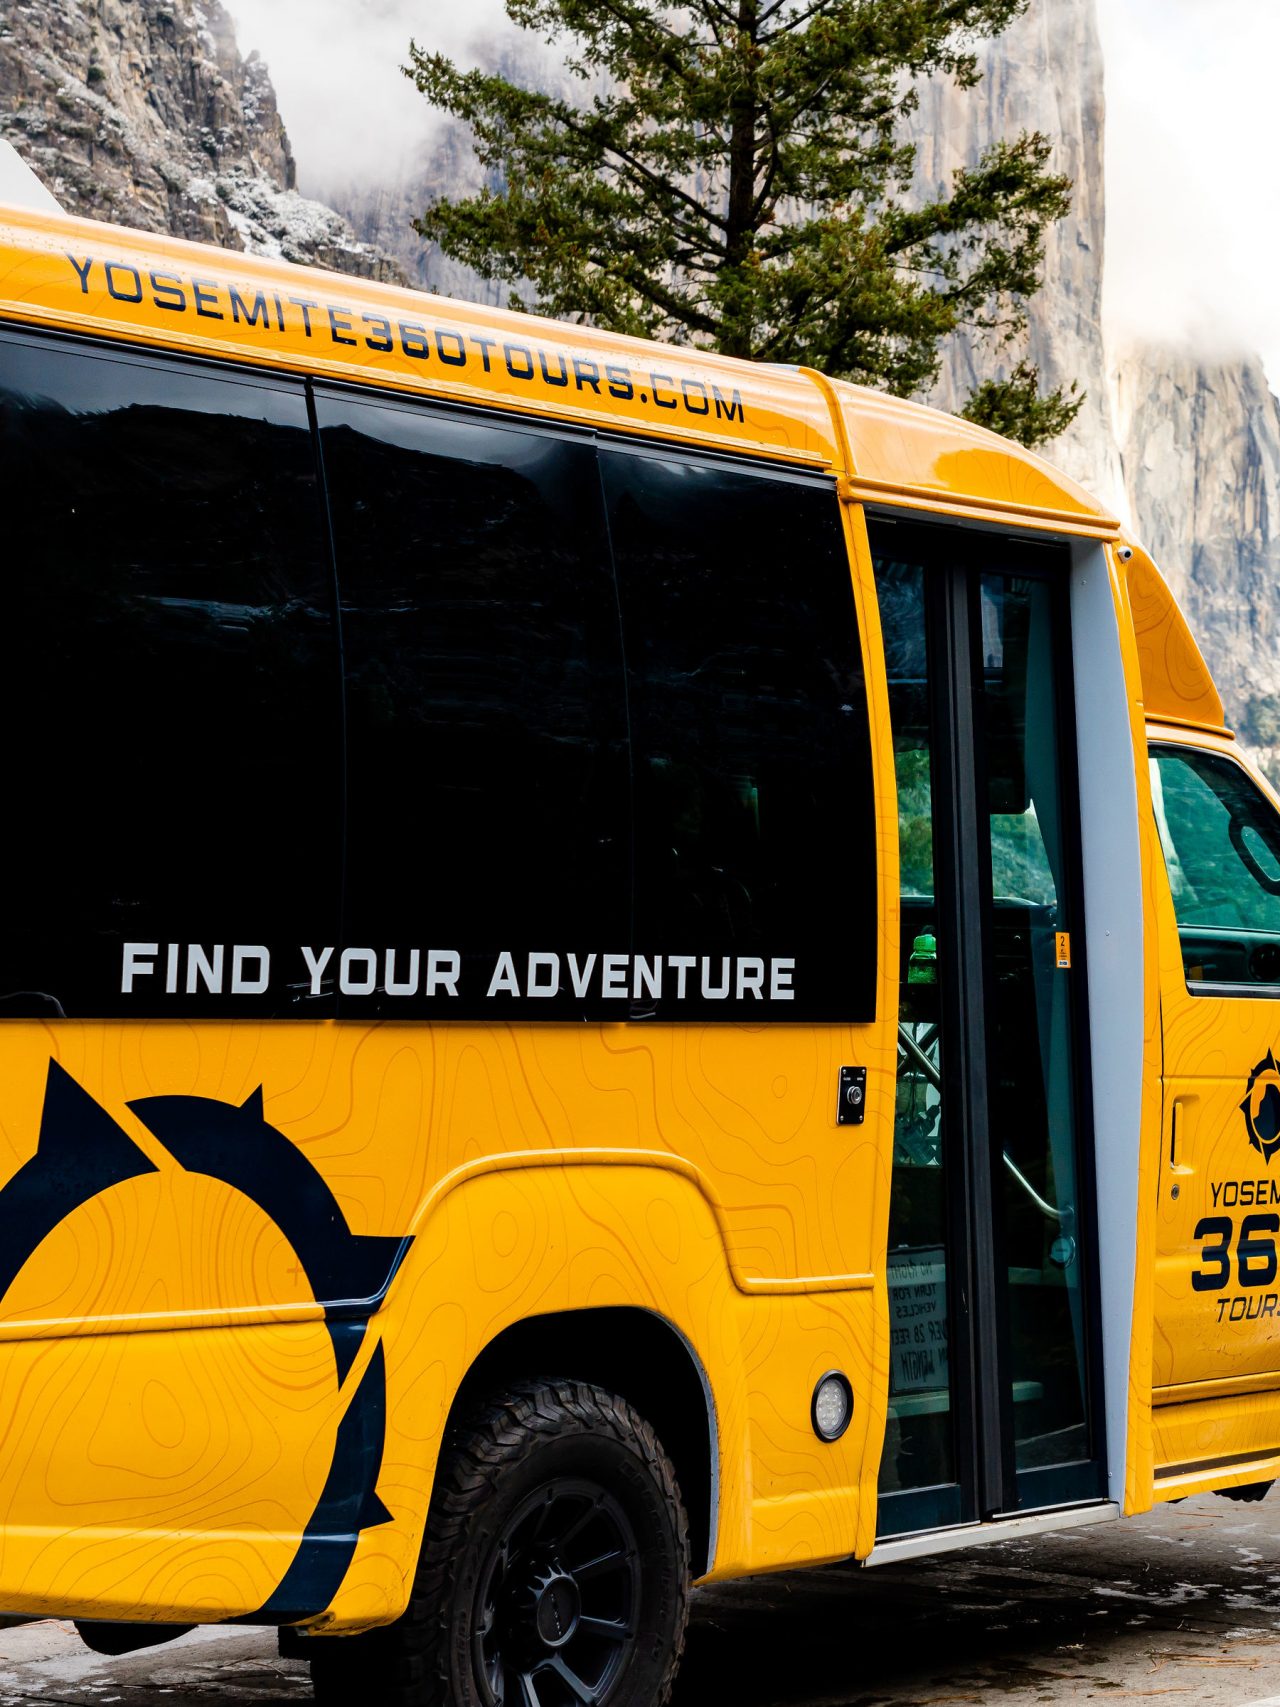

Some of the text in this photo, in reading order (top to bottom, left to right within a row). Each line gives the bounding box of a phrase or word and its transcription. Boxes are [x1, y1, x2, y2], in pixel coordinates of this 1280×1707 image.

[66, 251, 745, 425] YOSEMITE360TOURS.COM
[120, 942, 796, 1000] FIND YOUR ADVENTURE
